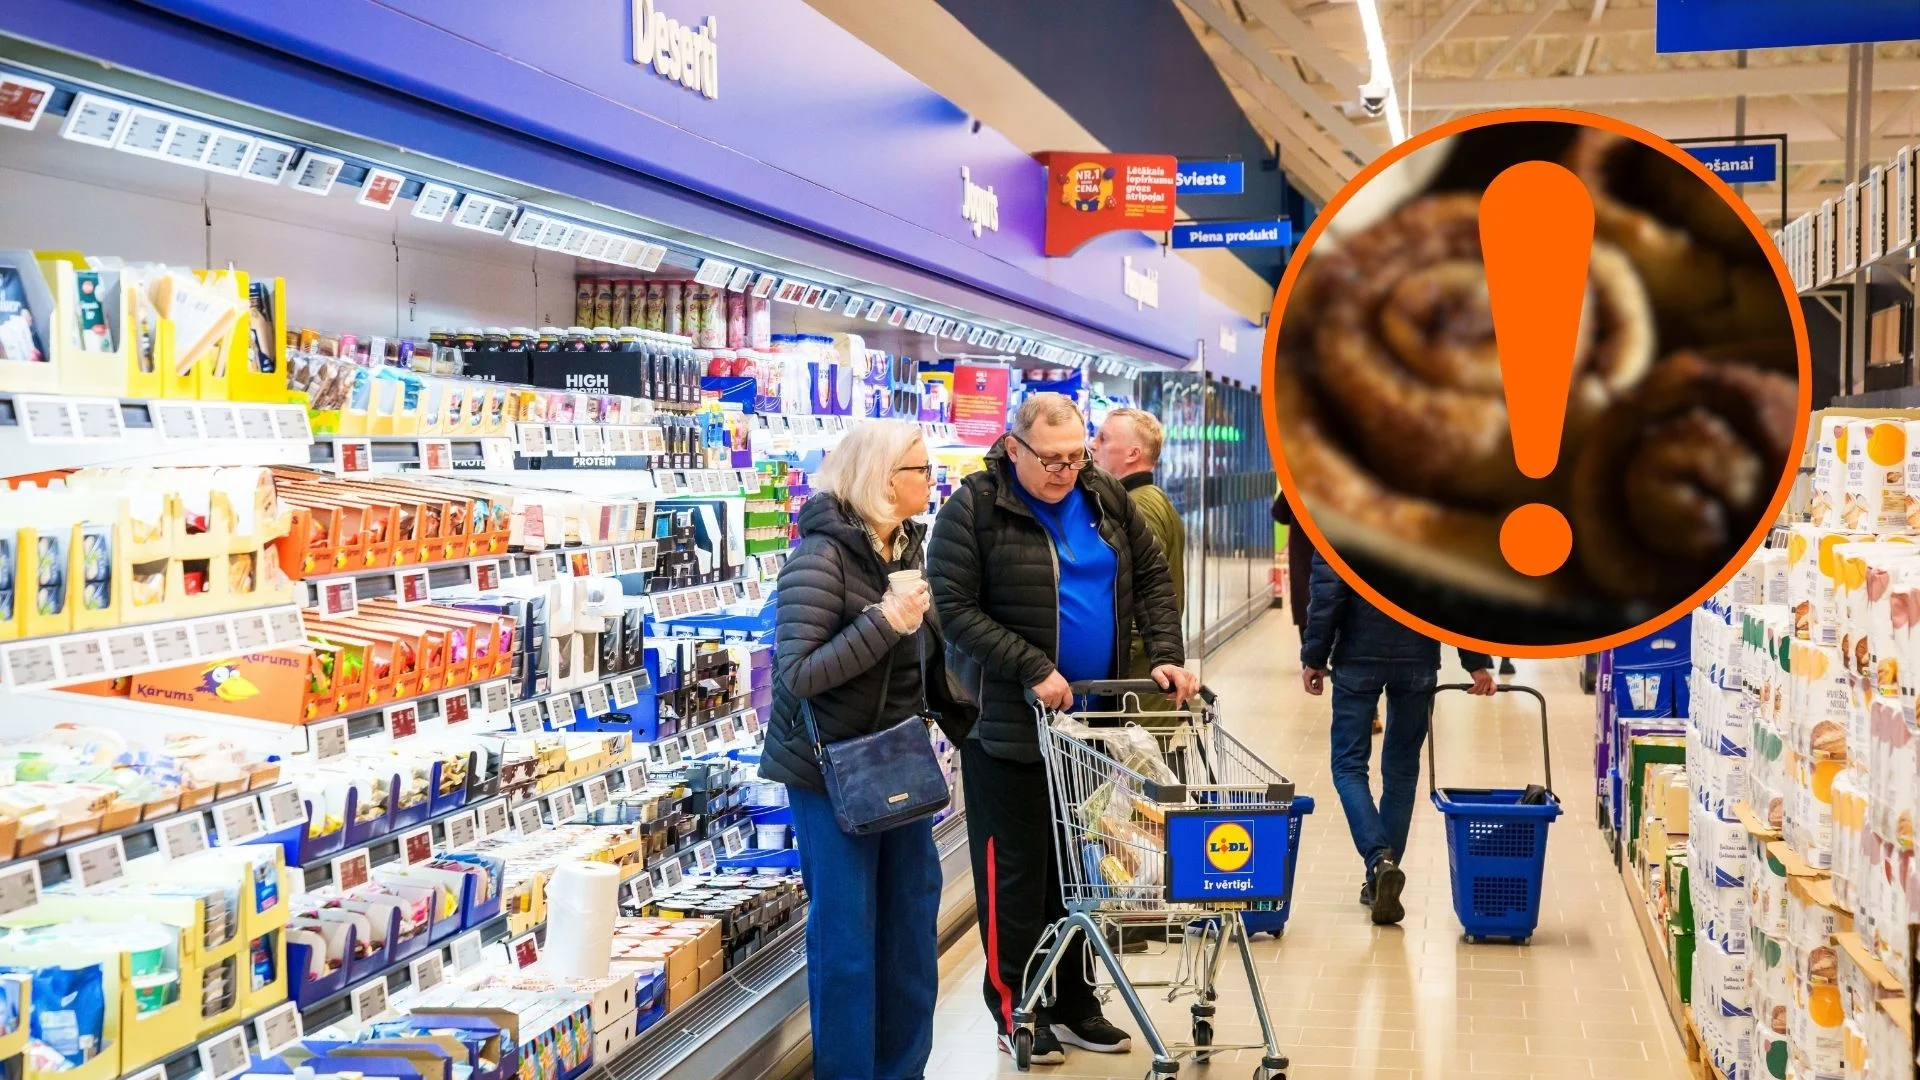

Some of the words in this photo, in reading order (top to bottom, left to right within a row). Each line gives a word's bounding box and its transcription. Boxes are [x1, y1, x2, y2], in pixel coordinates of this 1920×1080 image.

[631, 0, 718, 99] Deserti
[1704, 156, 1754, 172] ošanai
[1175, 171, 1227, 187] Sviests
[1075, 184, 1099, 193] CENA
[1189, 231, 1223, 243] Piena
[1226, 228, 1278, 244] produkti
[566, 374, 609, 387] HIGH
[573, 457, 616, 467] PROTEIN
[1204, 879, 1214, 890] Ir
[1215, 878, 1254, 892] vērtīgi.
